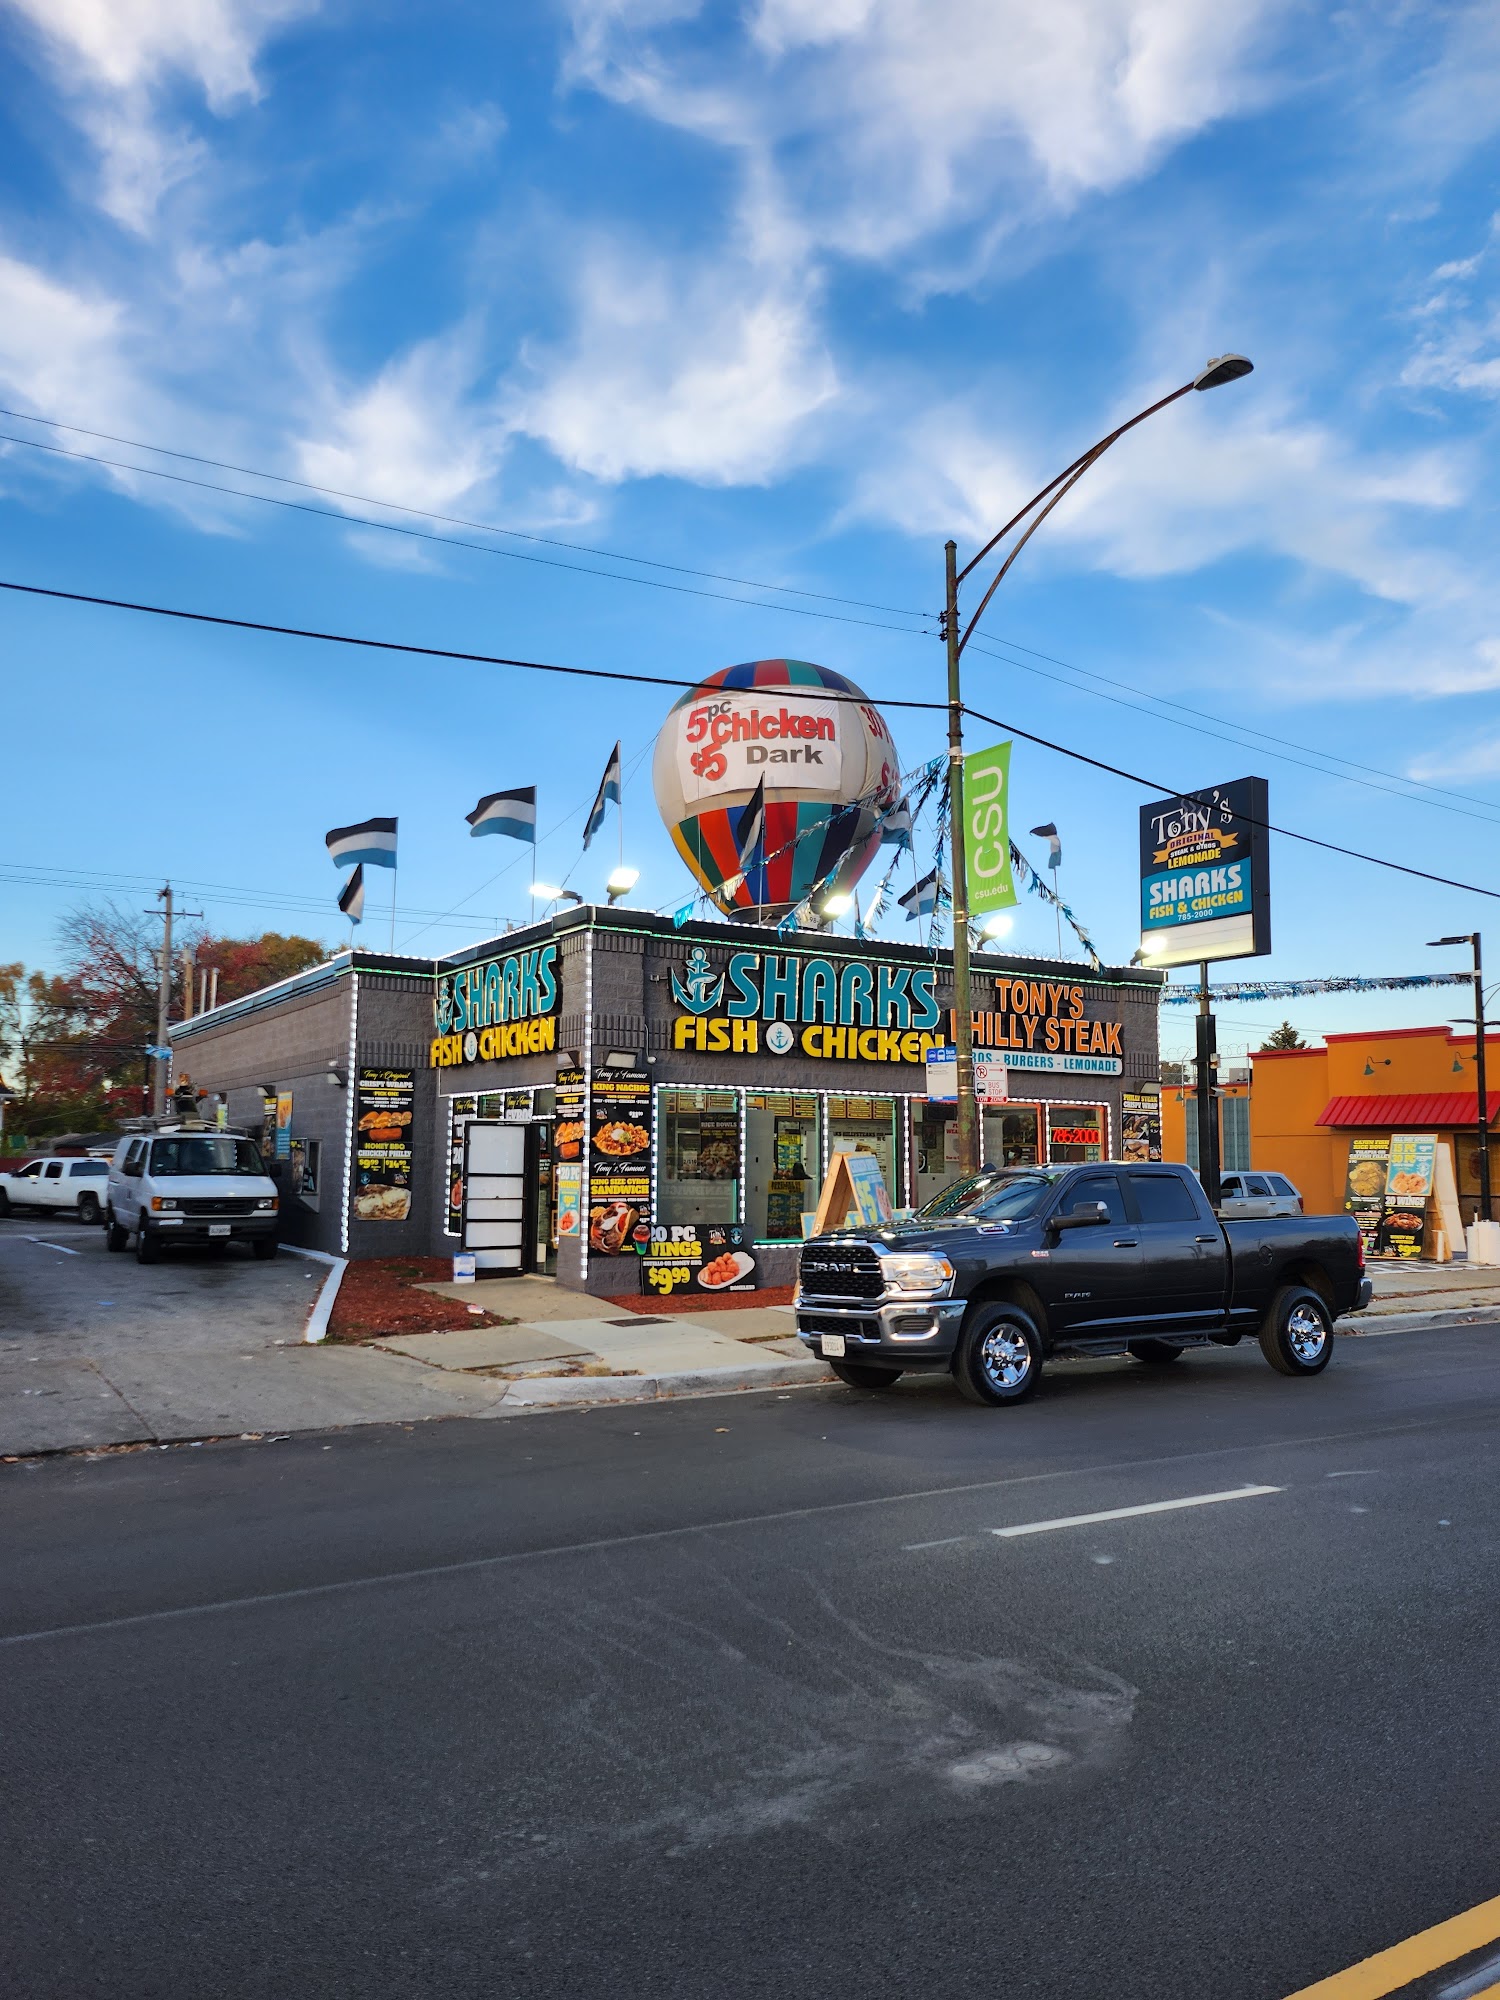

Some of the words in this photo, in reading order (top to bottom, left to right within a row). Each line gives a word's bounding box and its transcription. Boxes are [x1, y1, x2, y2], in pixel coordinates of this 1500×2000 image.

[711, 708, 835, 744] Chicken
[690, 741, 728, 781] $5
[746, 745, 823, 764] Dark
[972, 766, 1003, 878] CSU
[1151, 790, 1233, 845] Tony's
[1170, 832, 1215, 849] ORIGINAL
[1167, 848, 1221, 870] LEMONADE
[1170, 847, 1189, 858] STEAK
[975, 883, 1008, 900] csu.edu
[1149, 864, 1242, 906] SHARKS
[1149, 903, 1174, 920] FISH
[1177, 901, 1188, 914] &
[1191, 889, 1243, 911] CHICKEN
[1177, 909, 1213, 921] 785-2000
[453, 945, 556, 1032] SHARKS
[727, 952, 941, 1030] SHARKS
[995, 978, 1084, 1019] TONY'S
[431, 1034, 463, 1068] FISH
[479, 1016, 556, 1061] CHICKEN
[674, 1015, 758, 1053] FISH
[801, 1025, 945, 1064] CHICKEN
[1045, 1016, 1123, 1055] STEAK
[1004, 1053, 1054, 1069] BURGERS
[1064, 1059, 1117, 1072] LEMONADE
[596, 1067, 620, 1081] Tony's
[620, 1070, 648, 1079] Famous
[592, 1083, 615, 1091] KING
[616, 1084, 650, 1092] NACHOS
[1123, 1101, 1141, 1109] CRISPY
[1052, 1128, 1099, 1143] 785-2000
[358, 1149, 388, 1157] CHICKEN
[389, 1150, 412, 1158] PHILLY
[365, 1142, 389, 1150] HONEY
[560, 1166, 570, 1180] 20
[571, 1166, 580, 1180] PC
[594, 1162, 619, 1176] Tony's
[619, 1162, 646, 1172] Famous
[591, 1185, 649, 1194] SANDWICH
[1385, 1196, 1396, 1205] 20
[1397, 1197, 1425, 1206] WINGS
[670, 1226, 696, 1242] PC
[816, 1263, 851, 1272] RAM
